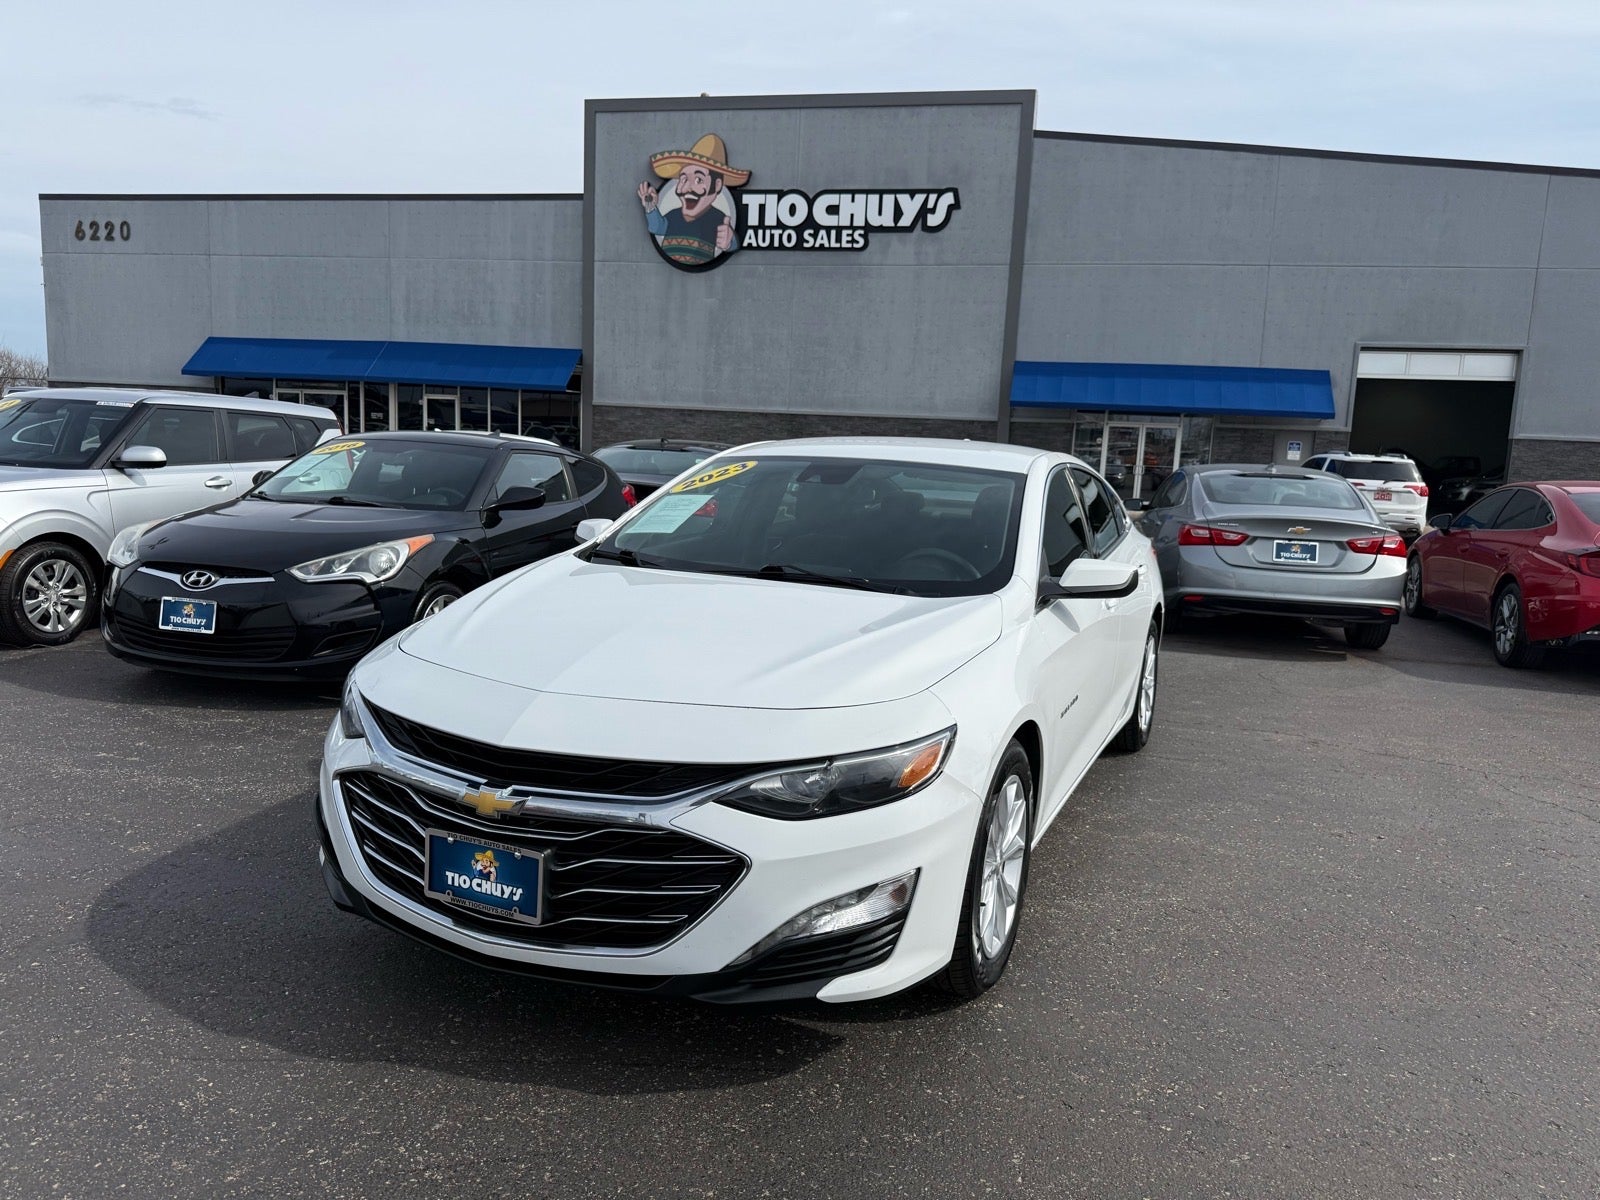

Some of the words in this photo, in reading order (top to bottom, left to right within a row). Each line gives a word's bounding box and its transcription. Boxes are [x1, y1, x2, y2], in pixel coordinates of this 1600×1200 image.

[742, 193, 808, 227] TIO
[812, 191, 955, 228] CHUY'S
[75, 219, 131, 241] 6220
[743, 229, 797, 248] AUTO
[803, 229, 865, 249] SALES
[681, 462, 748, 490] 2023
[170, 616, 182, 624] TIO
[483, 840, 501, 849] AUTO
[502, 844, 522, 854] SALES
[445, 870, 470, 889] TIO
[471, 878, 523, 901] CHUY'S
[450, 897, 514, 917] WWW.TIOCHUYS.COM
